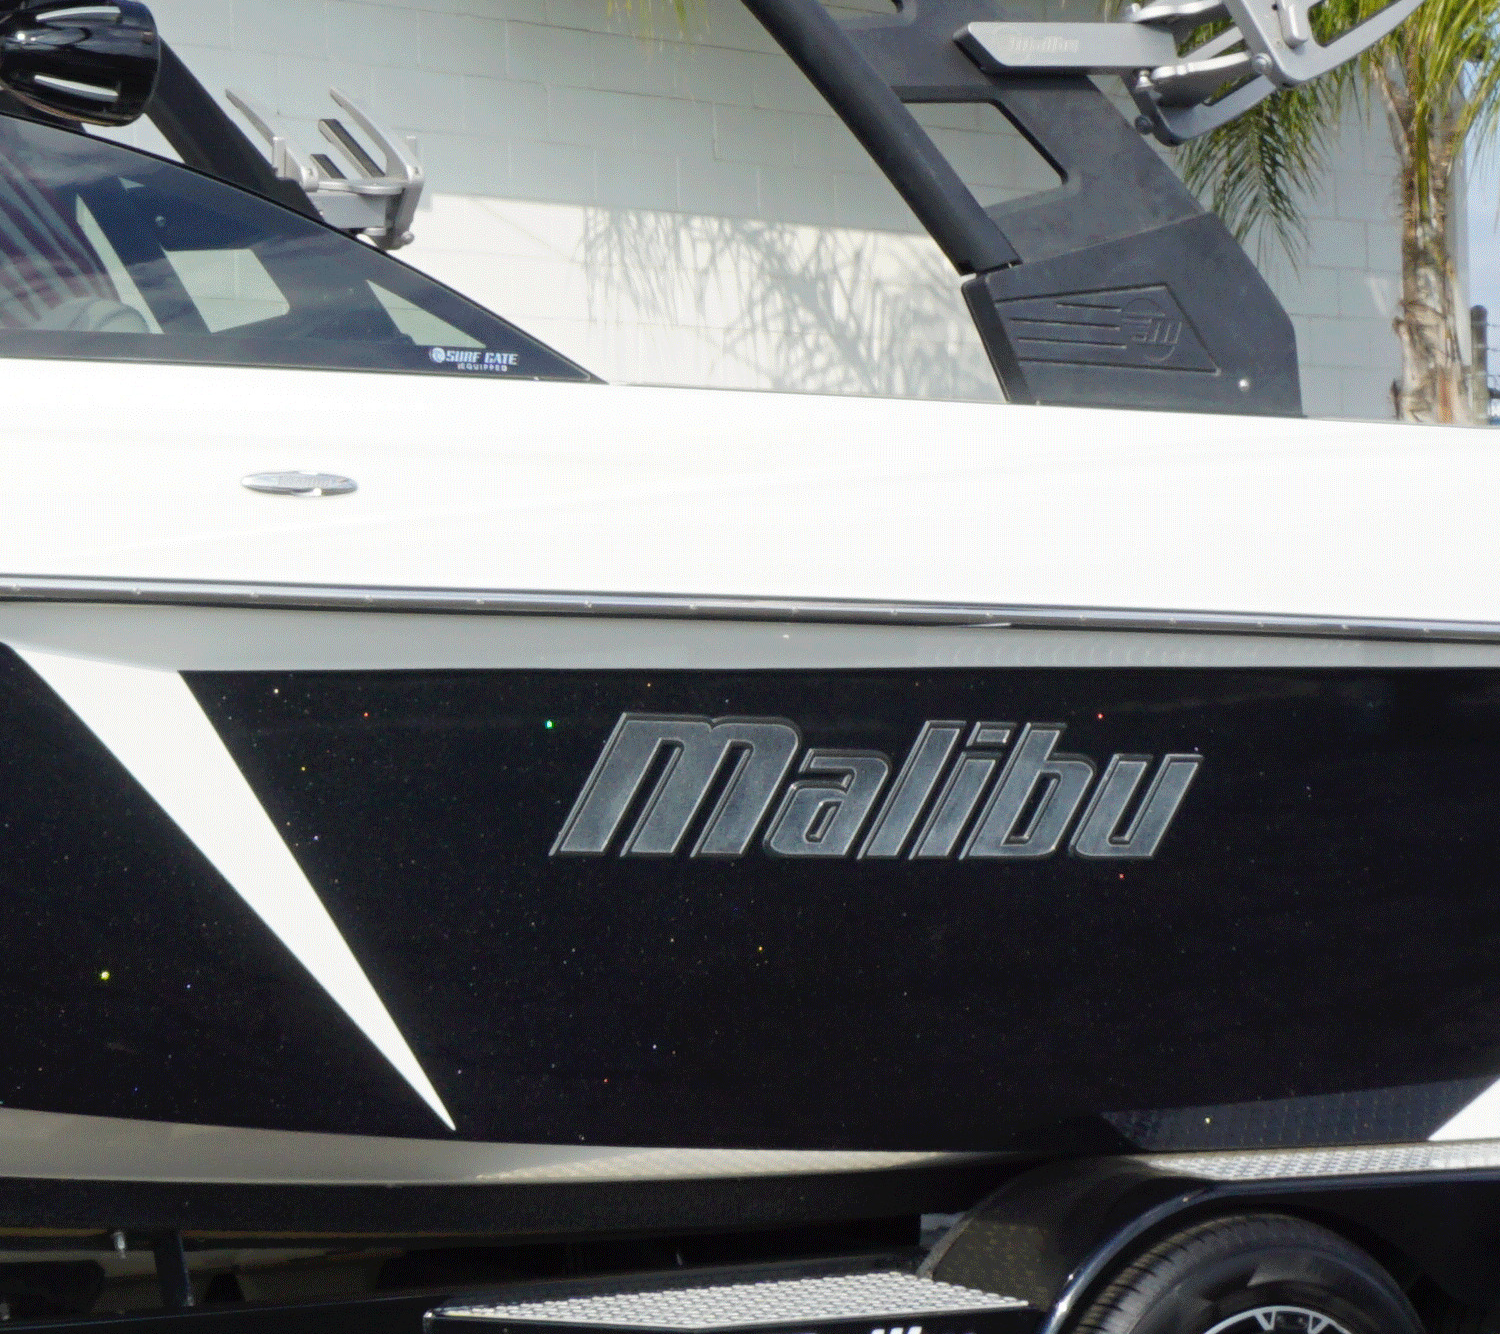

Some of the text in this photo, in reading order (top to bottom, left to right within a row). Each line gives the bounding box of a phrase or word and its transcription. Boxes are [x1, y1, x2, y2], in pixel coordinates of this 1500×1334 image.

[445, 349, 519, 366] SURF GATE
[549, 712, 1202, 860] Malibu
